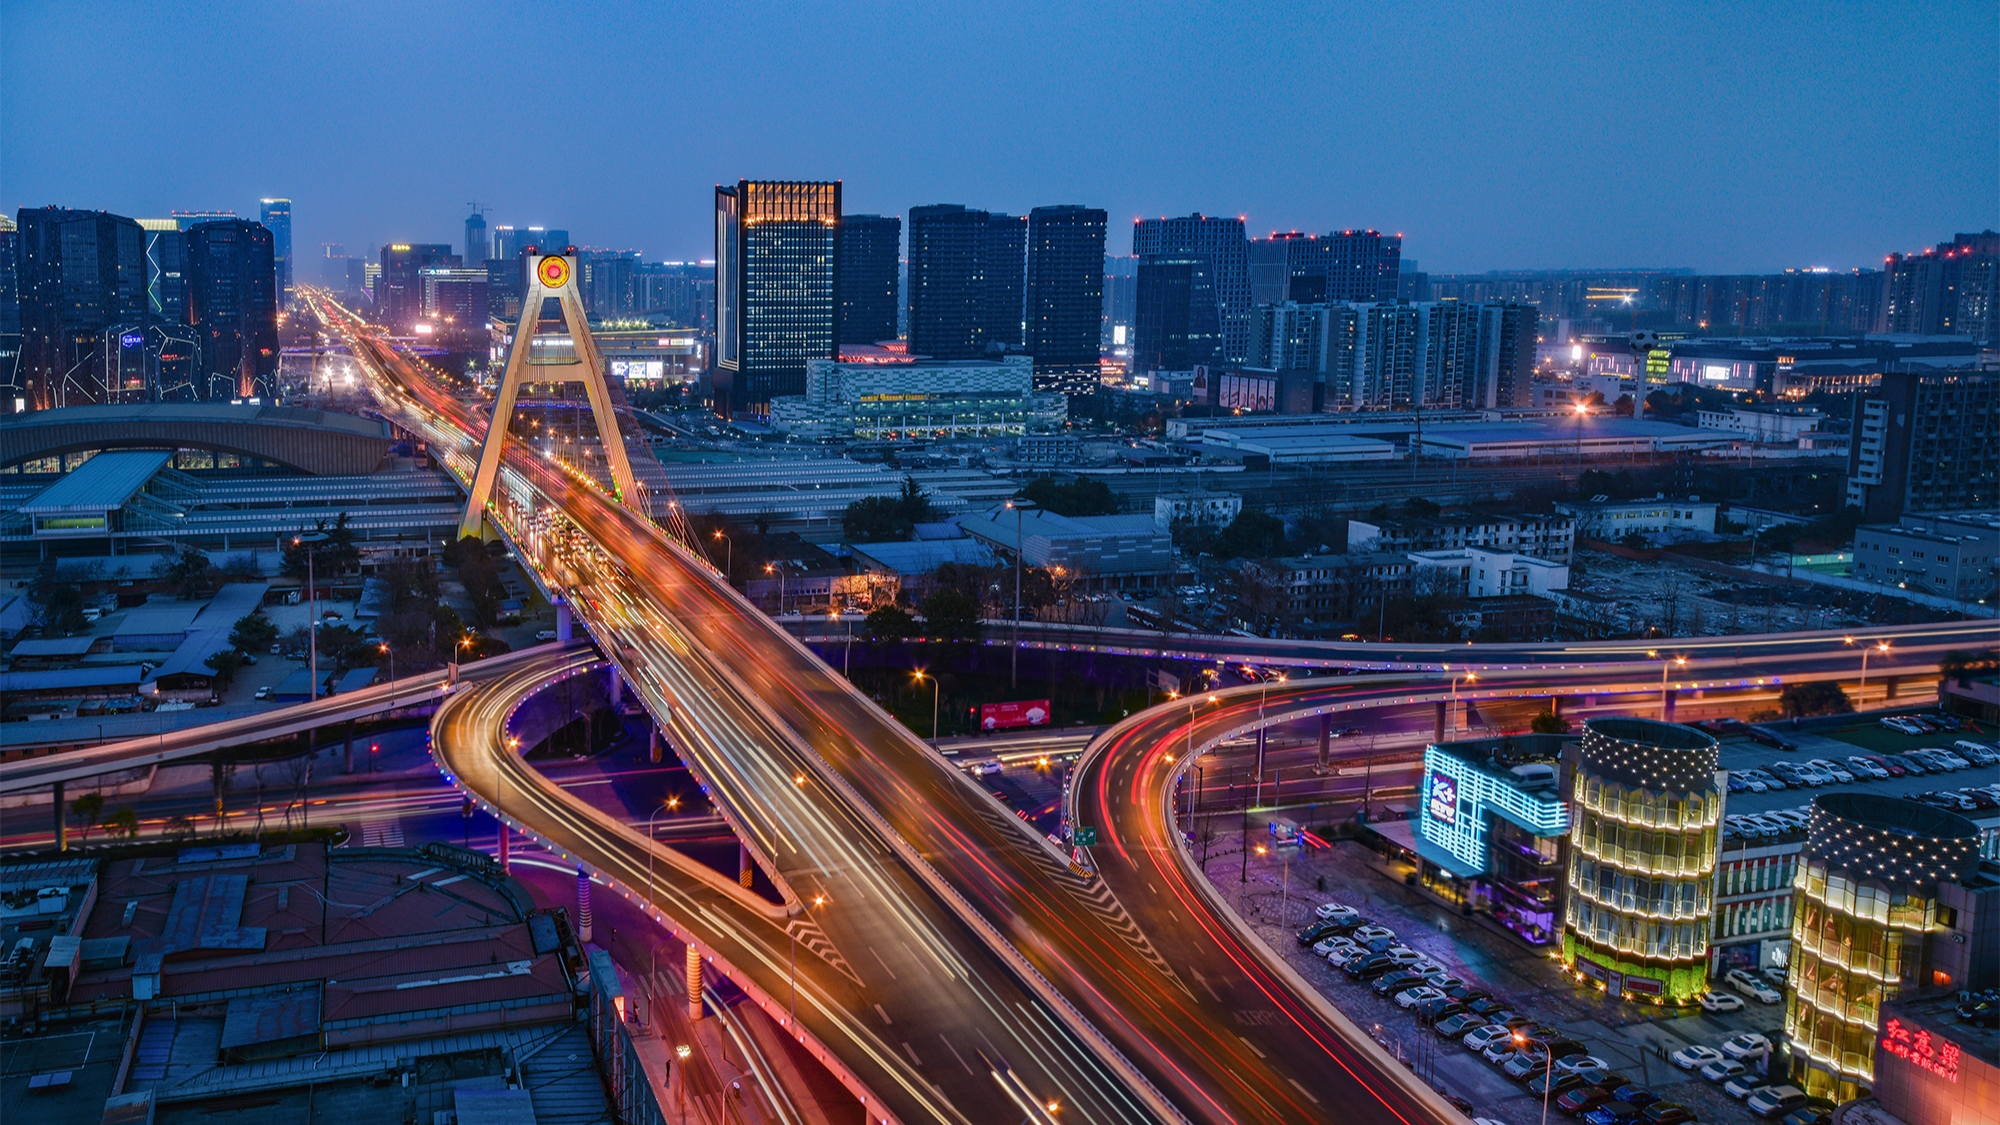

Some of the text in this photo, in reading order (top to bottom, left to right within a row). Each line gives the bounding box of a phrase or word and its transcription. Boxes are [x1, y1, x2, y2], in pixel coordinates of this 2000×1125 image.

[1431, 798, 1455, 817] KTV
[1232, 1010, 1290, 1026] AIRPO
[1886, 1018, 1960, 1070] 红高粱
